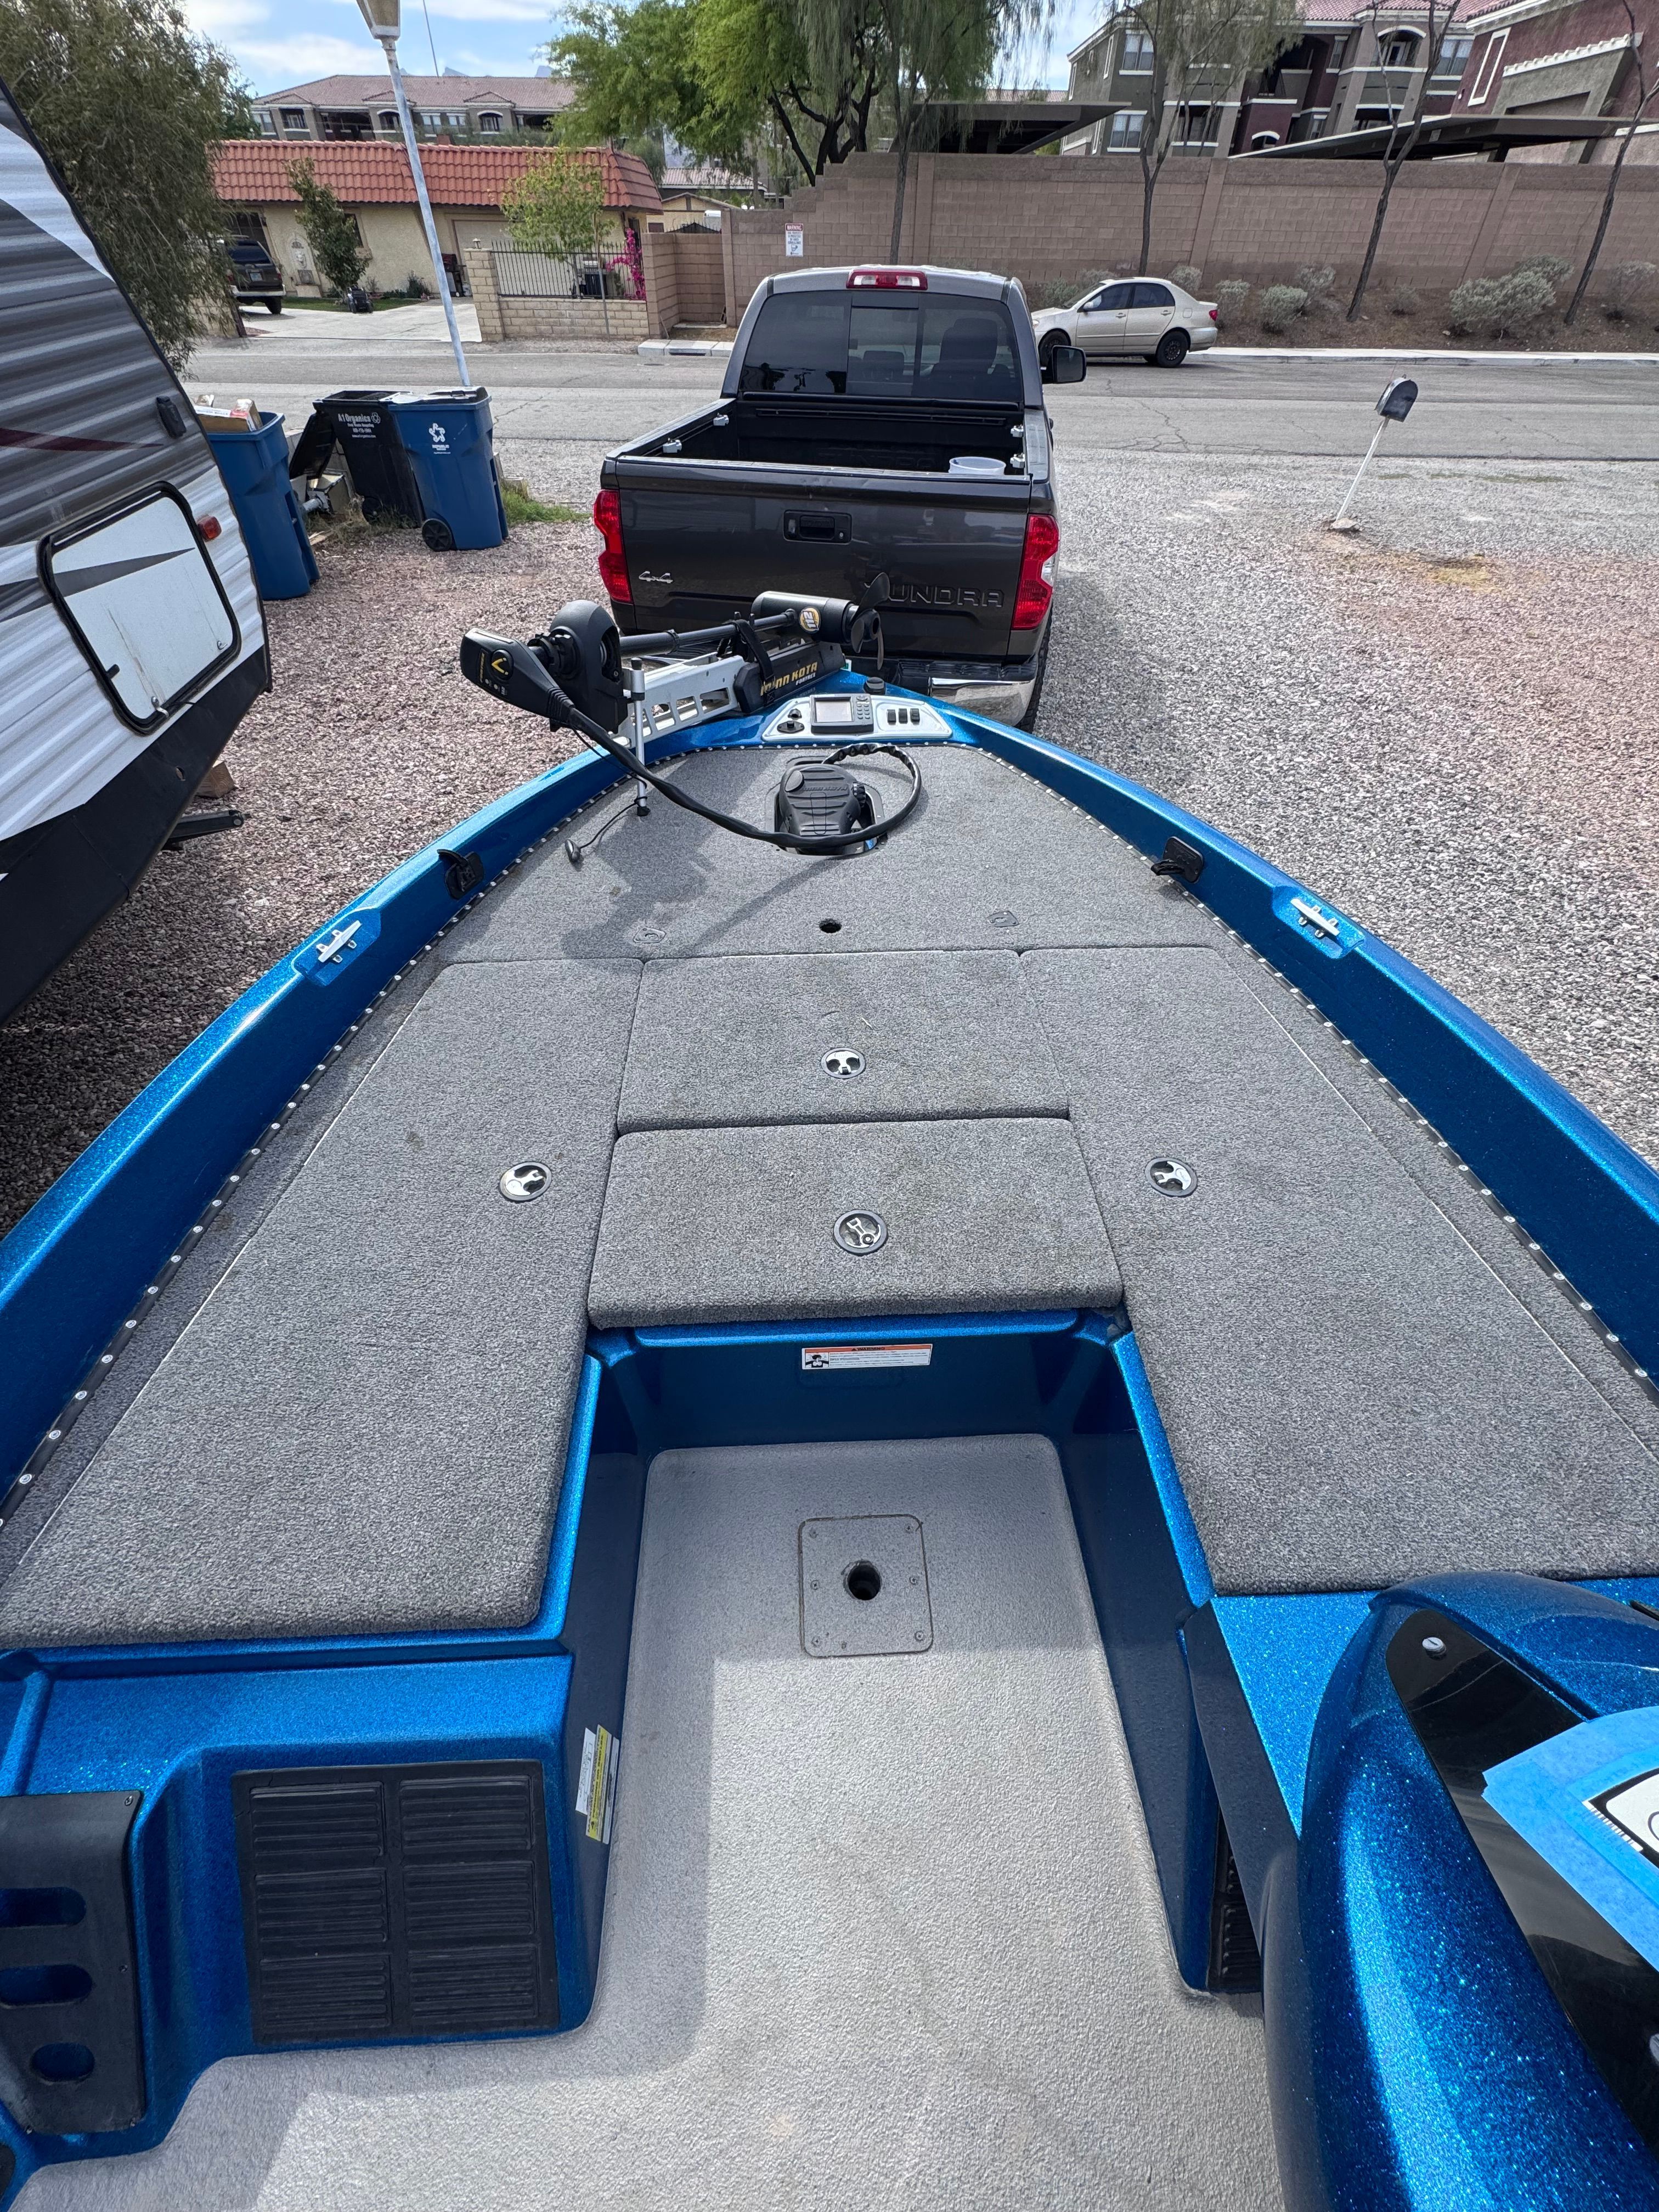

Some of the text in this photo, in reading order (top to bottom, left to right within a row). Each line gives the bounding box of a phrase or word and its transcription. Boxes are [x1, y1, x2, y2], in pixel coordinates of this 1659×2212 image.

[345, 413, 371, 426] Organics
[639, 571, 673, 584] 4x4
[864, 577, 1005, 607] UNDRA
[791, 661, 818, 682] KOTA
